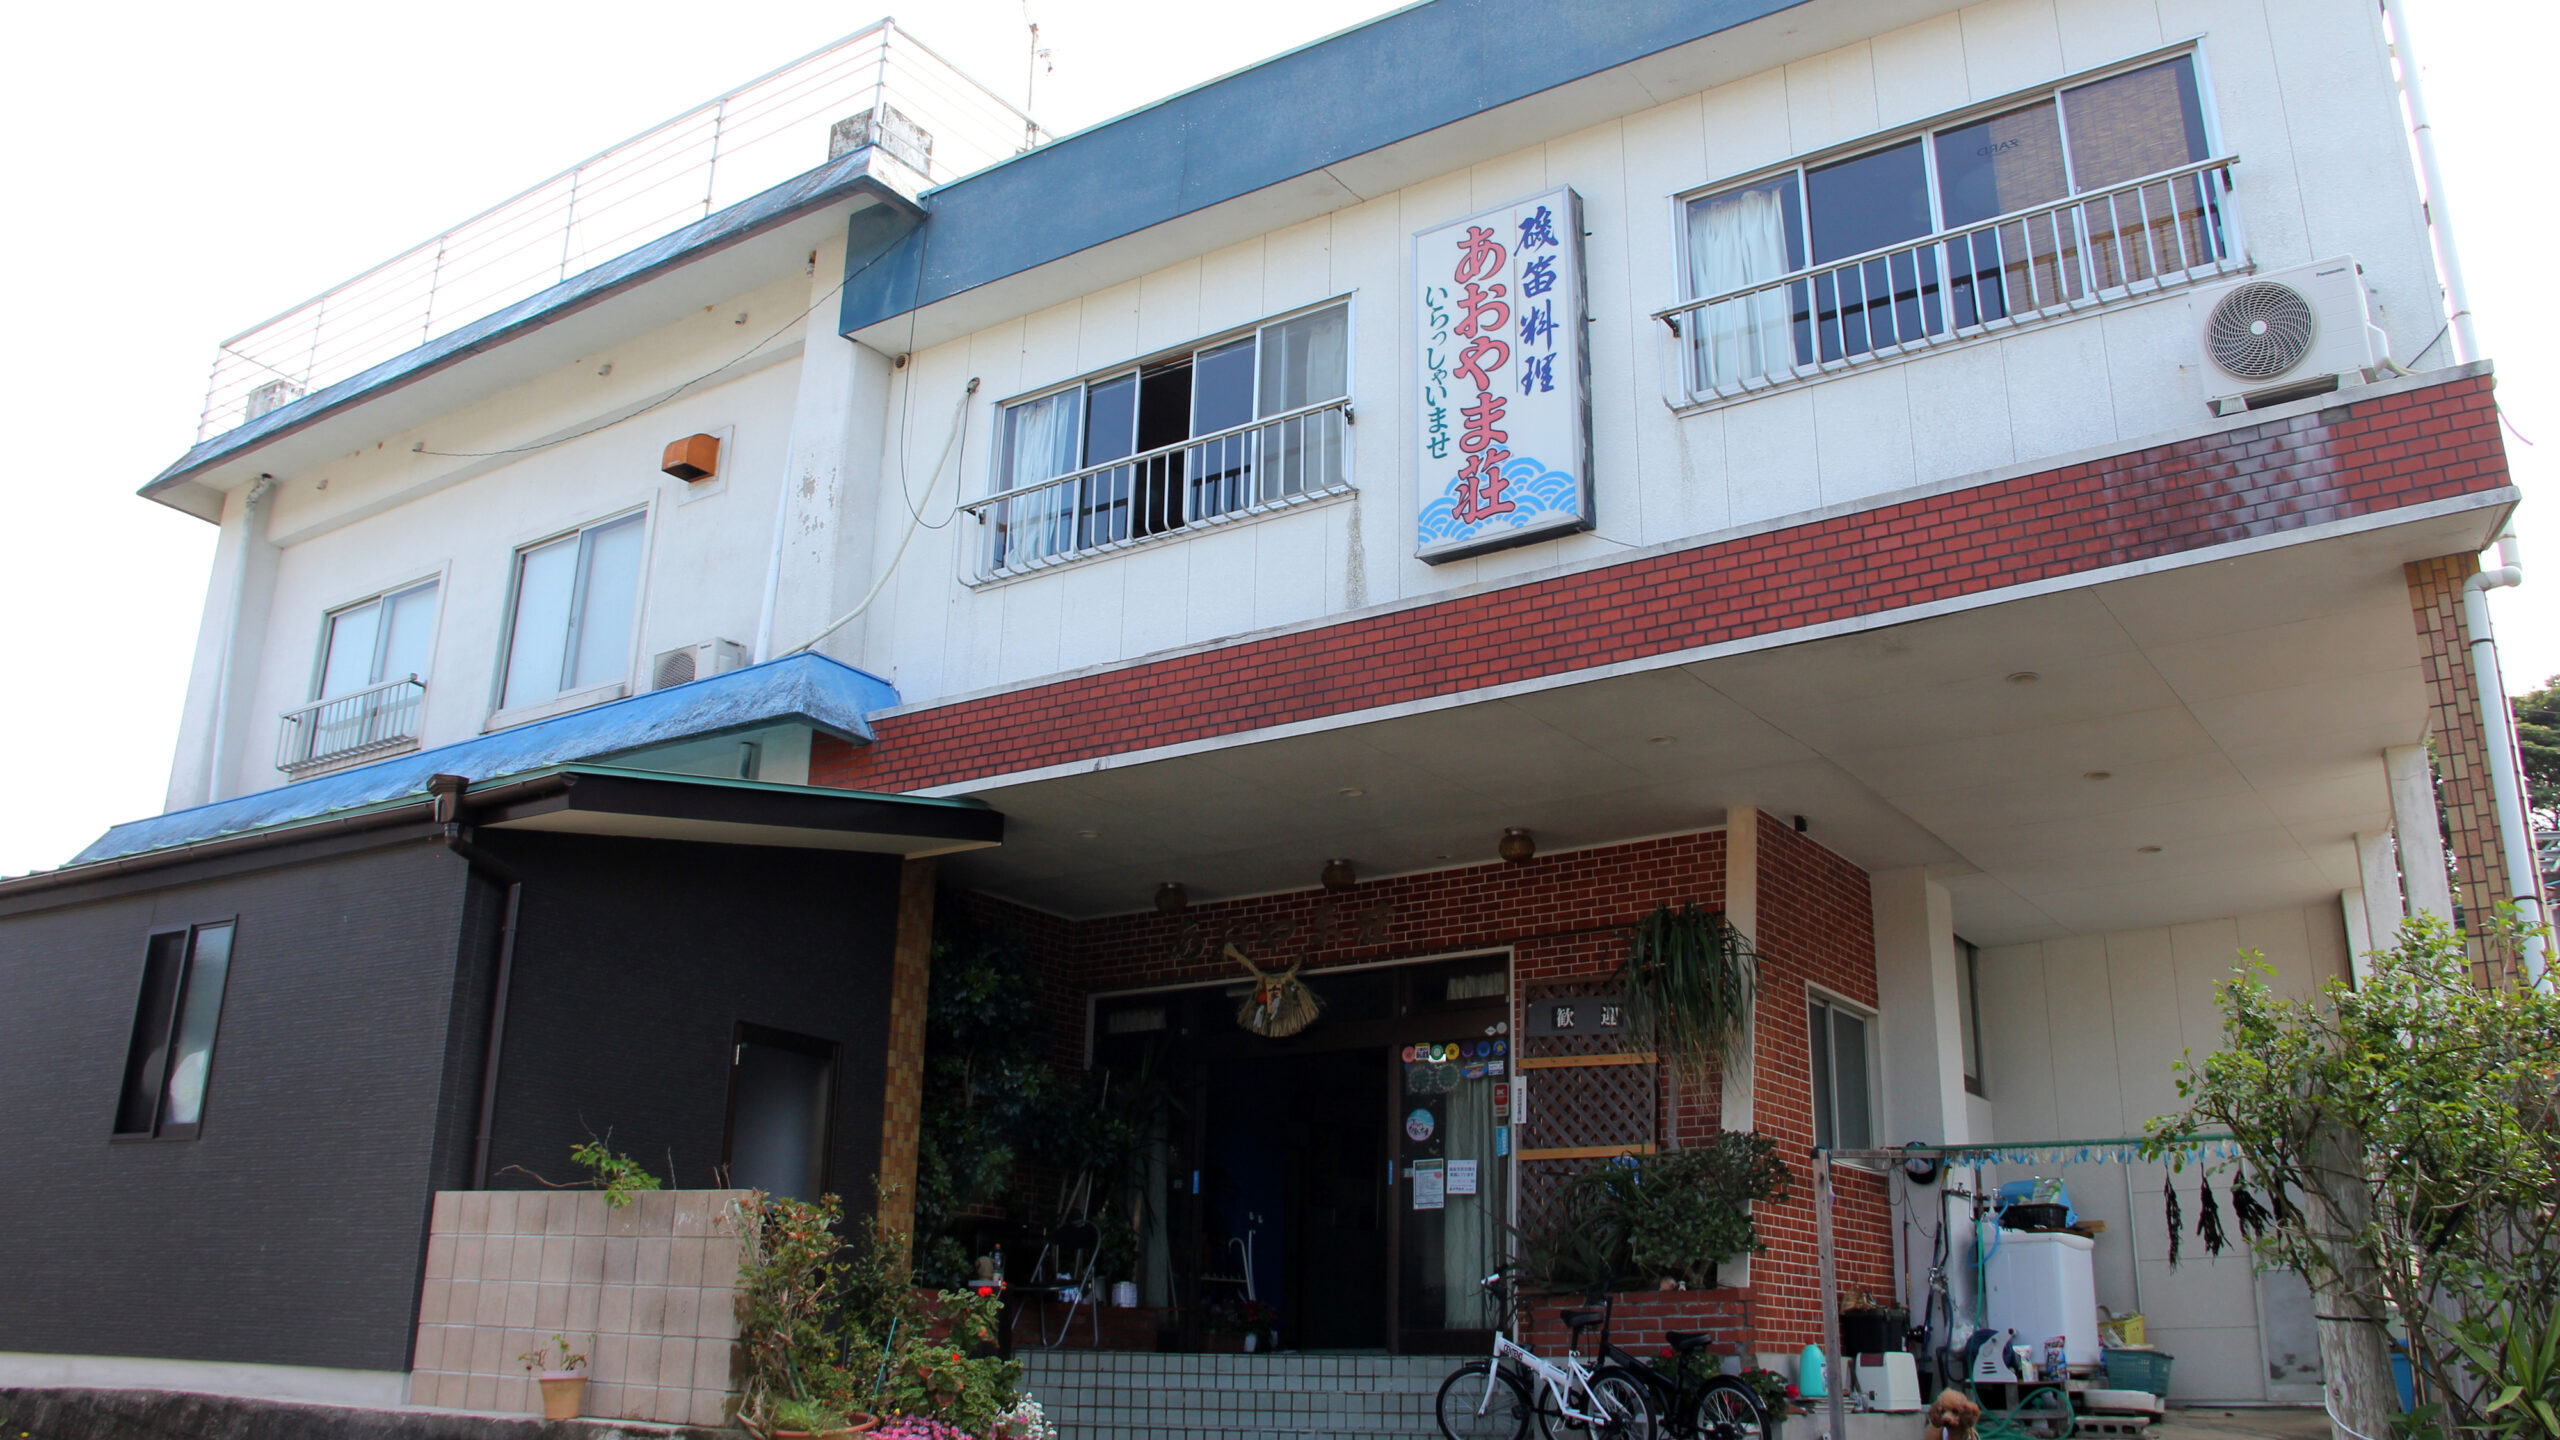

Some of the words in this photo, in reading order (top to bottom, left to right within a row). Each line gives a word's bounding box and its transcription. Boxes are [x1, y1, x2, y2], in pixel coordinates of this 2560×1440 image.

[1425, 286, 1450, 459] いらっしゃいませ
[1453, 225, 1516, 525] あおやま荘
[1514, 205, 1559, 396] 磯笛料理
[1556, 1006, 1620, 1028] 歓迎
